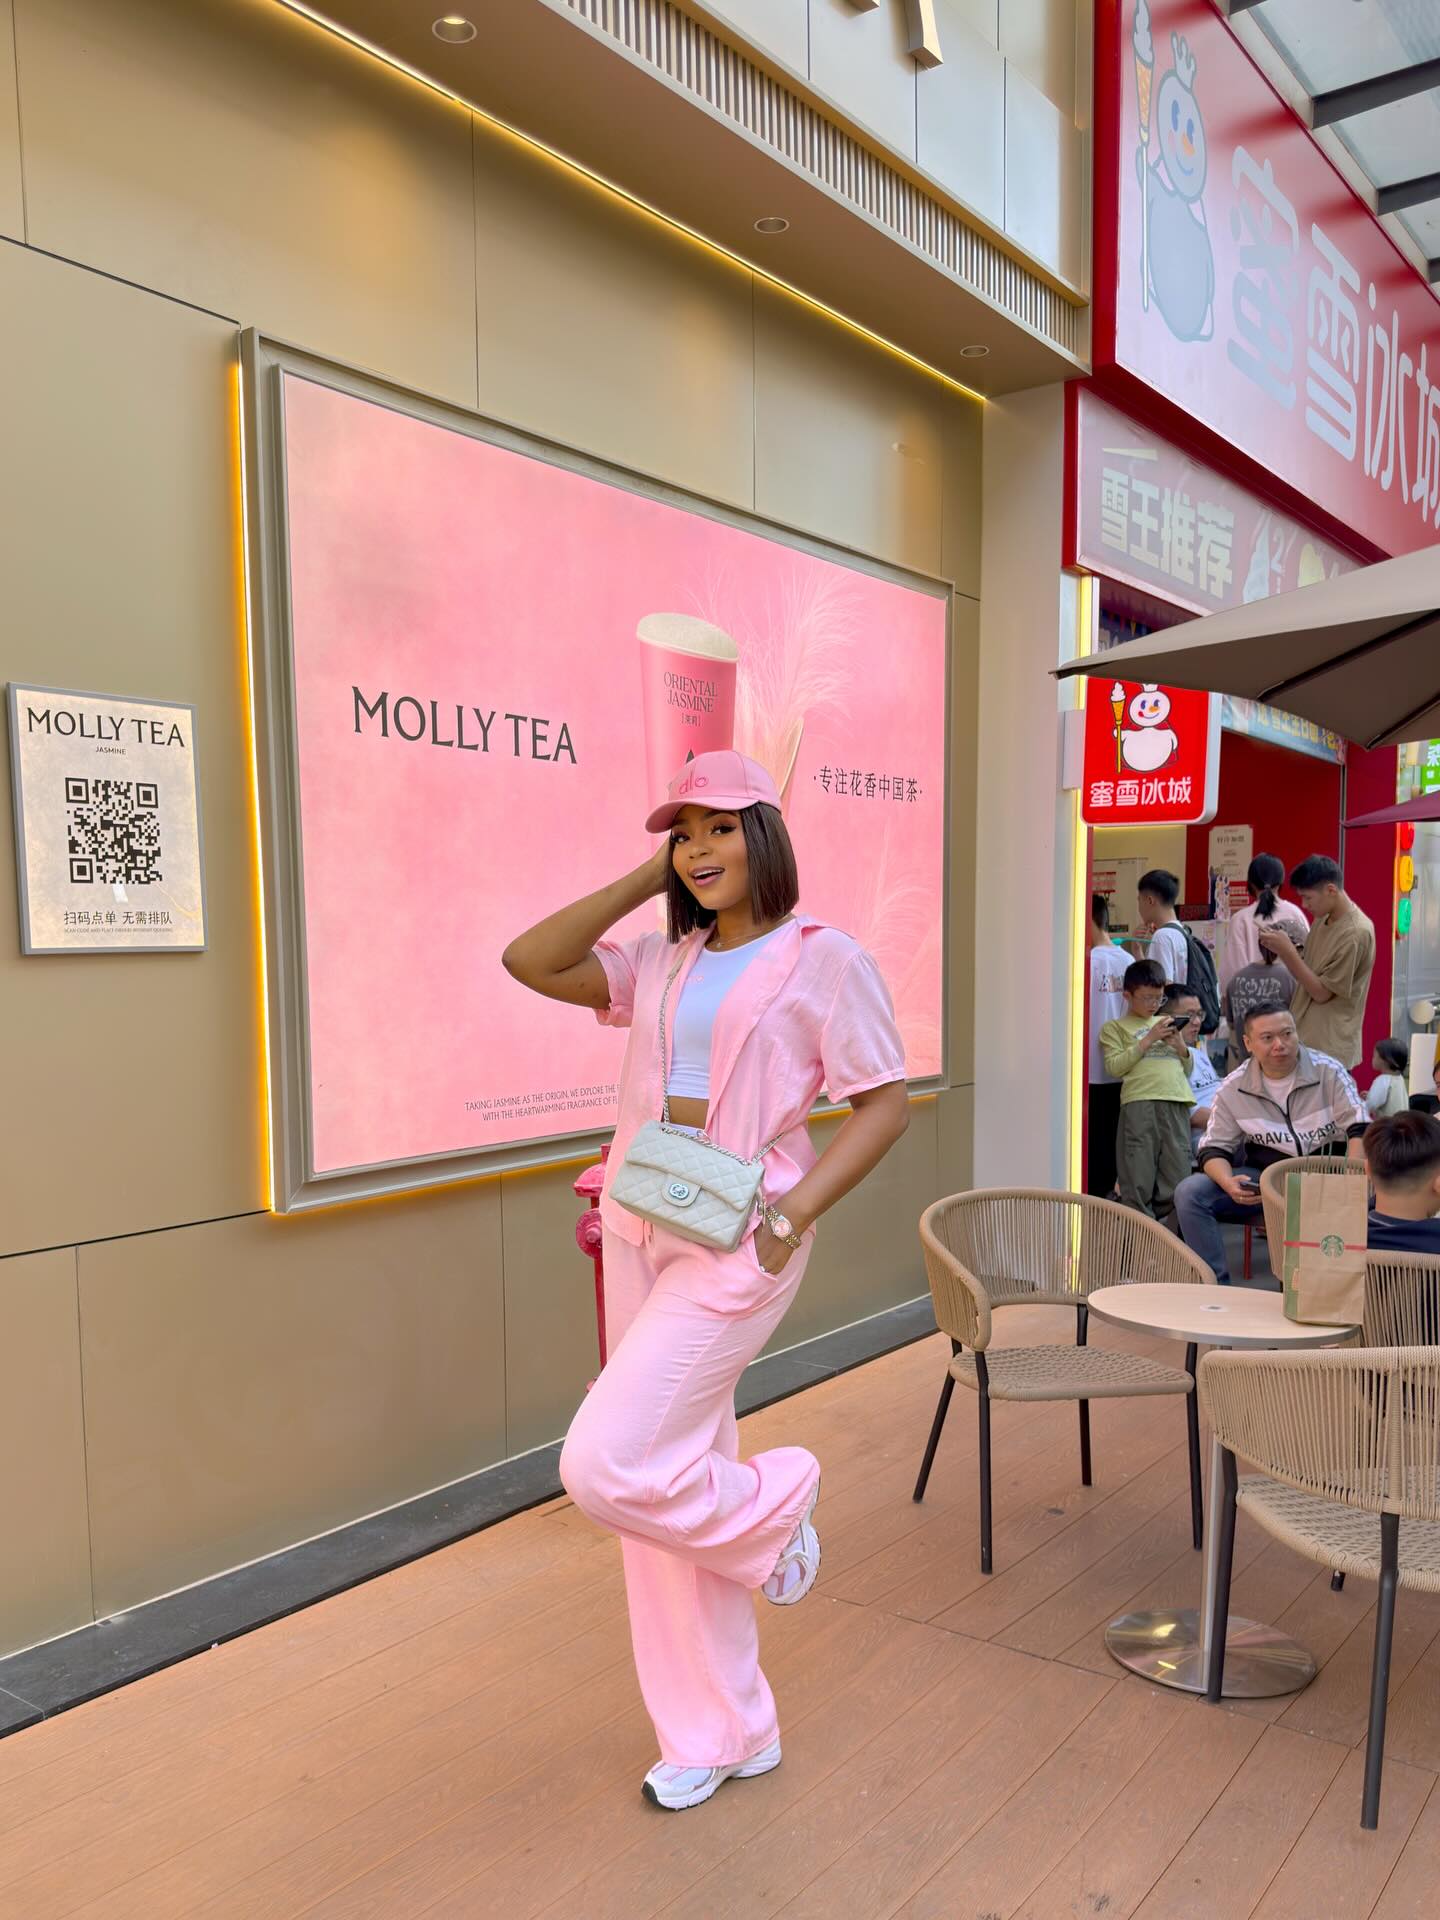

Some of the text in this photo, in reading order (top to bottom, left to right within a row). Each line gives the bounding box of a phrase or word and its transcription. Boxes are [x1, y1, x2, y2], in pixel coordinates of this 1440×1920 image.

[1101, 466, 1235, 601] 雪王推荐
[664, 671, 718, 697] ORIENTAL
[667, 689, 714, 713] JASMINE
[27, 707, 185, 748] MOLLY TEA
[351, 685, 578, 765] MOLLY TEA
[96, 746, 127, 755] JASMINE
[678, 769, 709, 796] alo
[1089, 776, 1192, 807] 蜜雪冰城
[64, 911, 173, 925] 扫码点单 无需排队
[464, 1100, 493, 1111] TAKING
[493, 1098, 521, 1109] JASMINE
[522, 1095, 531, 1104] AS
[532, 1093, 544, 1103] THE
[570, 1088, 579, 1098] WE
[580, 1085, 604, 1096] EXPLORE
[605, 1083, 616, 1094] THE
[482, 1110, 500, 1121] WITH
[501, 1109, 514, 1119] THE
[514, 1102, 566, 1118] HEARTWARMING
[567, 1099, 602, 1111] FRAGRANCE
[602, 1097, 612, 1106] OF
